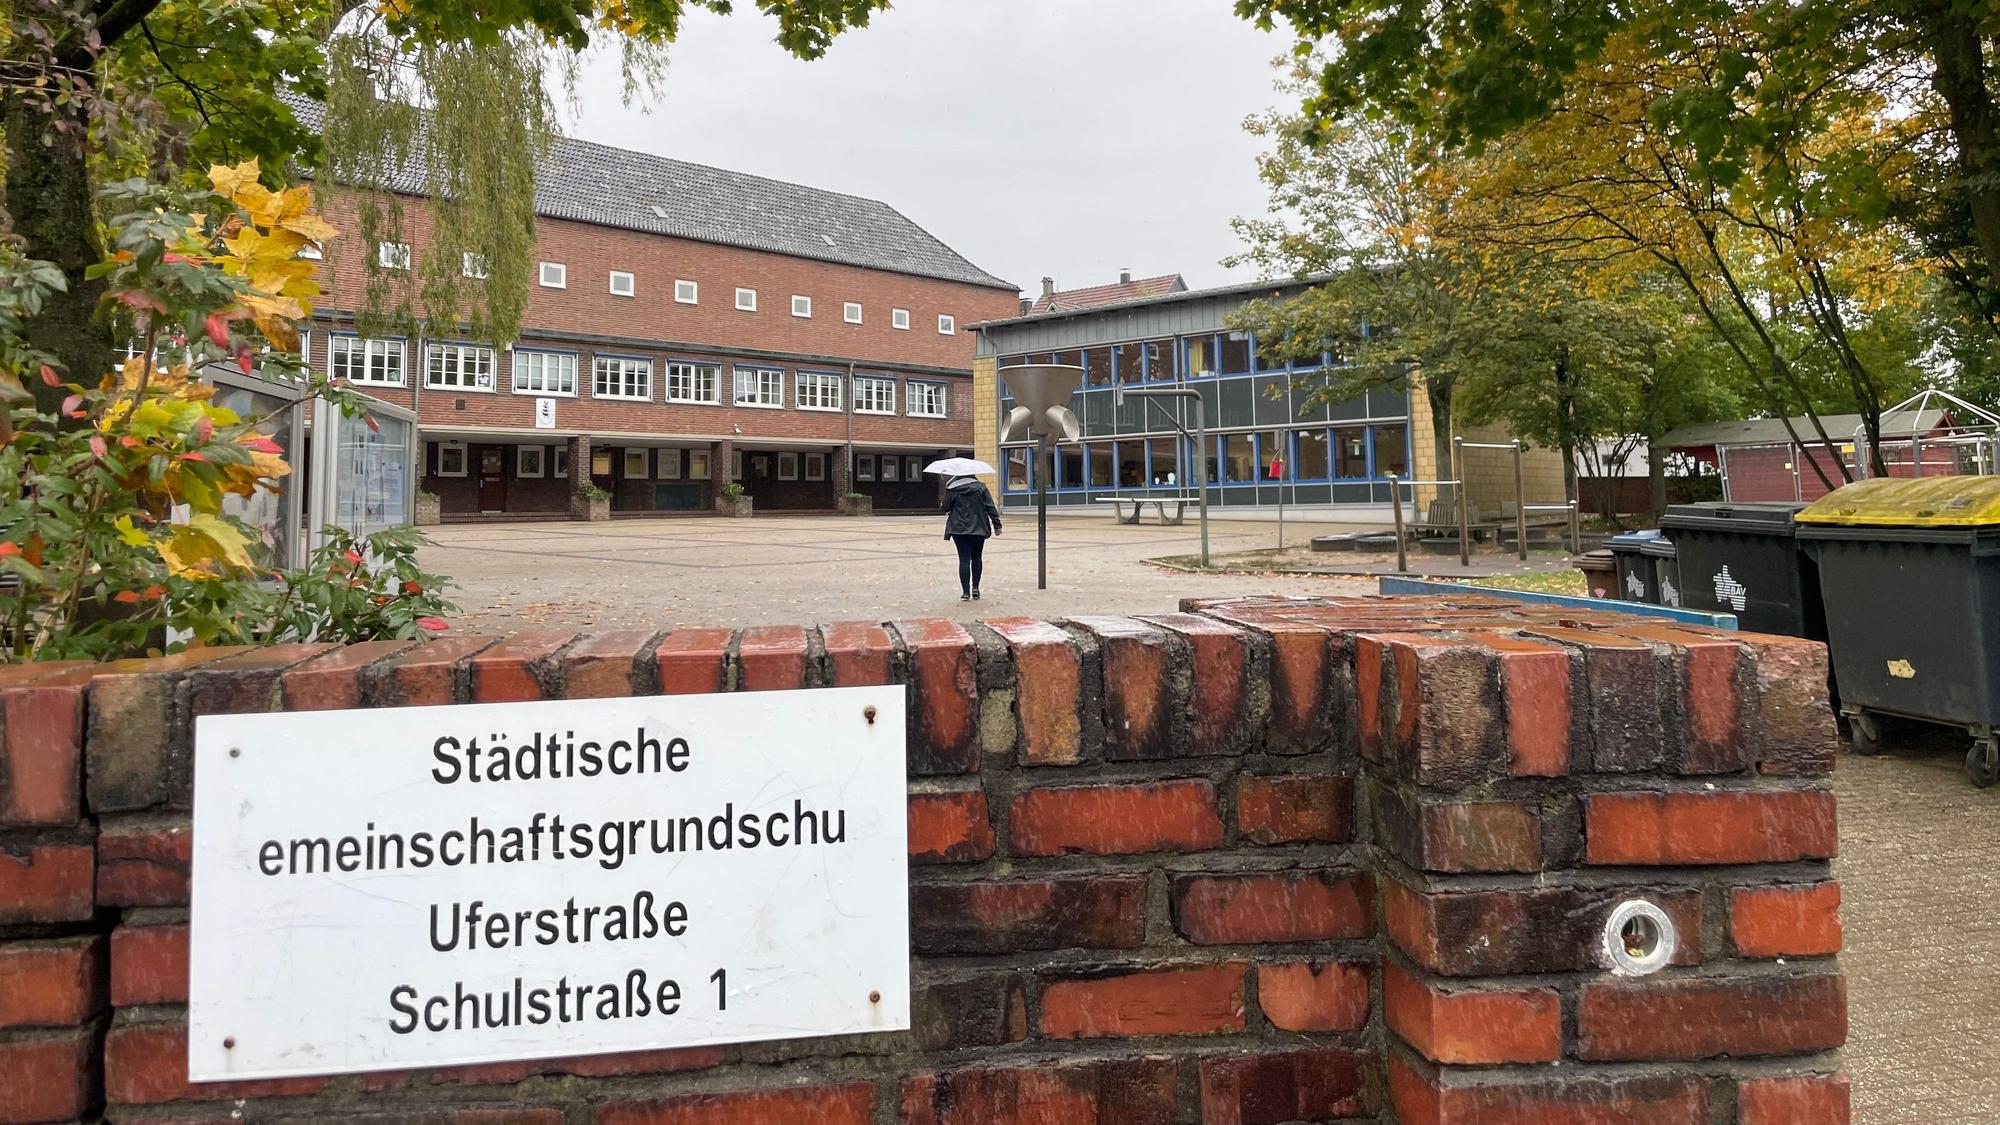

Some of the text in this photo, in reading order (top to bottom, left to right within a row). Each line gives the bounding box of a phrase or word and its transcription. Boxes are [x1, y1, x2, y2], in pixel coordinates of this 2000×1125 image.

[1730, 586, 1747, 596] BAV
[431, 727, 691, 785] Städtische
[258, 800, 846, 876] emeinschaftsgrundschu
[430, 890, 689, 952] Uferstraße
[389, 967, 727, 1035] Schulstraße 1
